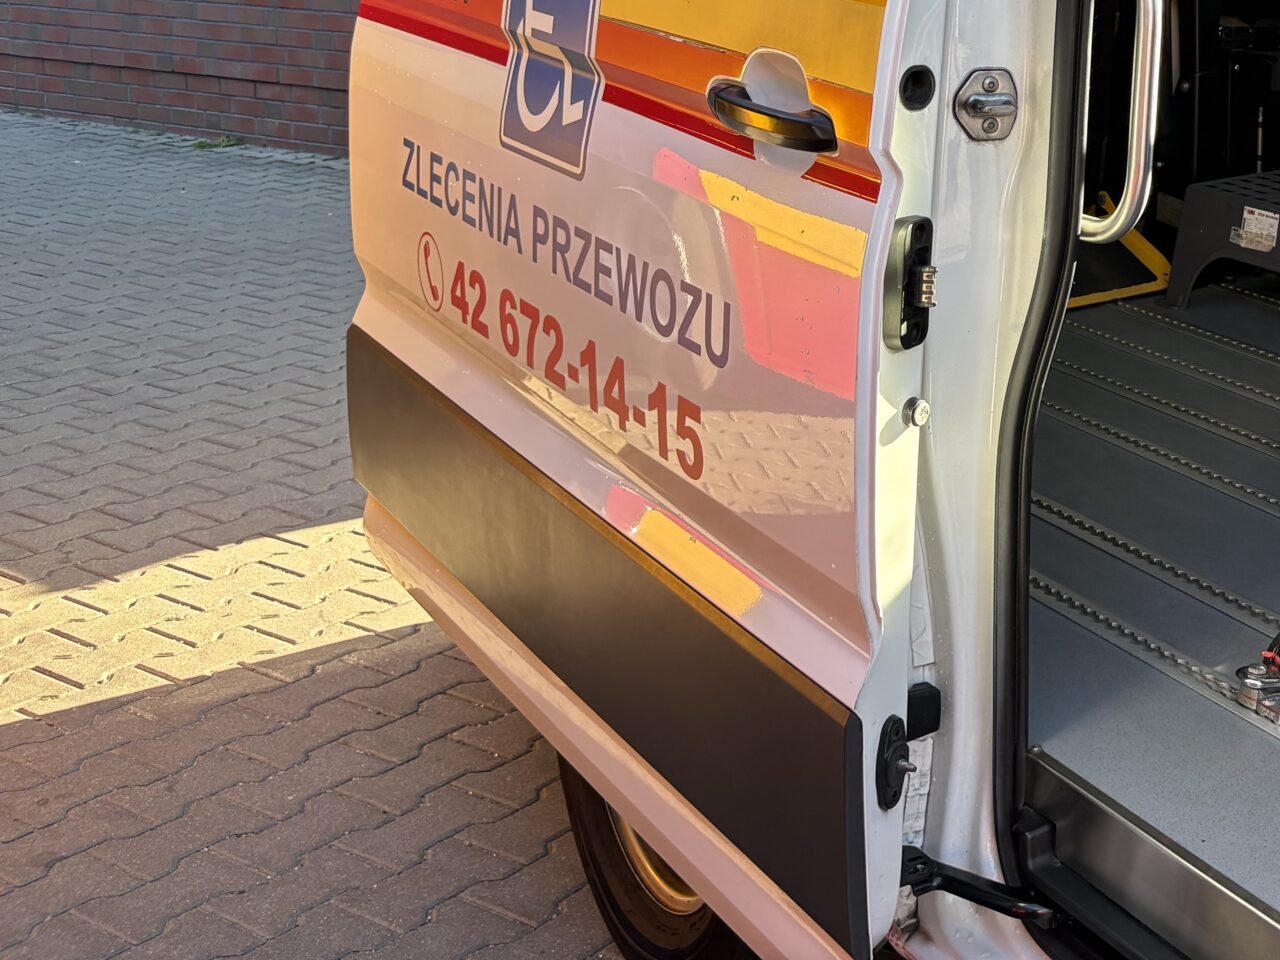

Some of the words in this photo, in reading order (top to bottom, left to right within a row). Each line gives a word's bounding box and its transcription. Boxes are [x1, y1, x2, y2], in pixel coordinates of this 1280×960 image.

[401, 137, 522, 255] ZLECENIA
[533, 205, 731, 369] PRZEWOZU
[450, 260, 490, 340] 42
[500, 297, 704, 481] 672-14-15
